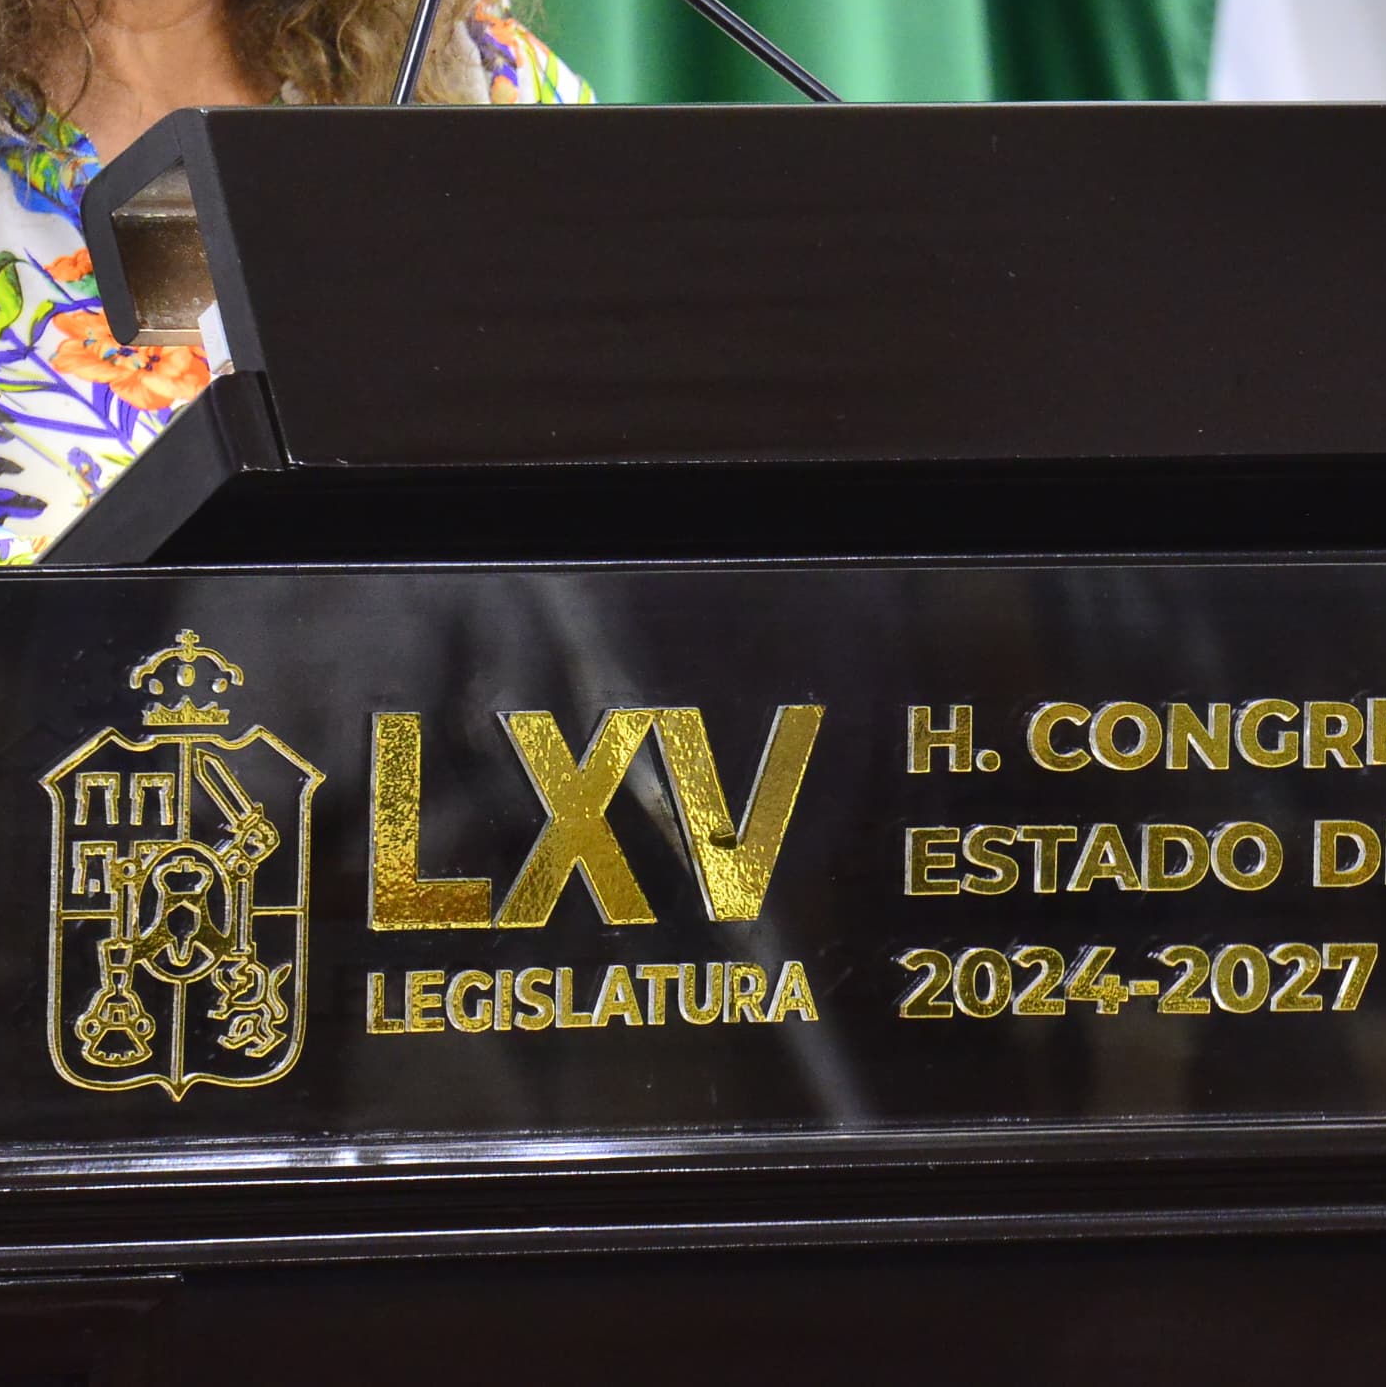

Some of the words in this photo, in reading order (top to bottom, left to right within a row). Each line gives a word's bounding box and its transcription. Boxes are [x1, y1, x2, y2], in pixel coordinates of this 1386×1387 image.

[905, 704, 1001, 774] H.
[369, 705, 825, 930] LXV
[904, 820, 1284, 896] ESTADO
[367, 960, 819, 1034] LEGISLATURA
[899, 942, 1379, 1018] 2024-2027
